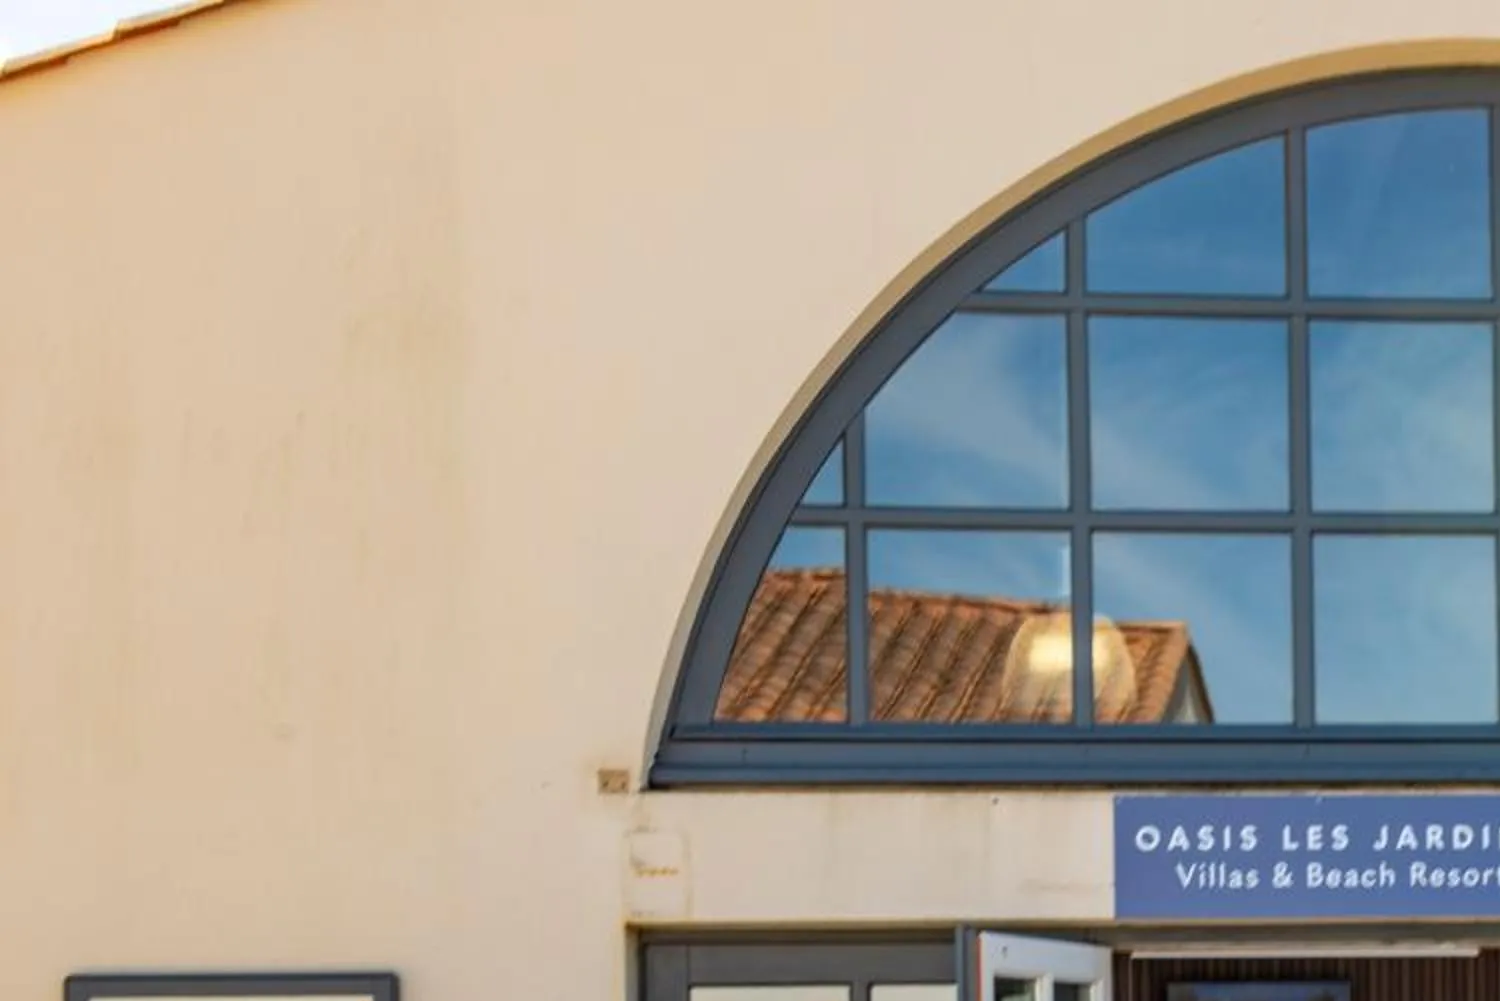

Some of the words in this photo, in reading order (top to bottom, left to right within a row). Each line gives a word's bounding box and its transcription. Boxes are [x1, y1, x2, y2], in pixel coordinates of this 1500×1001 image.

[1135, 824, 1258, 852] OASIS
[1282, 824, 1349, 851] LES
[1175, 862, 1259, 889] Villas
[1271, 861, 1293, 889] &
[1306, 861, 1397, 888] Beach
